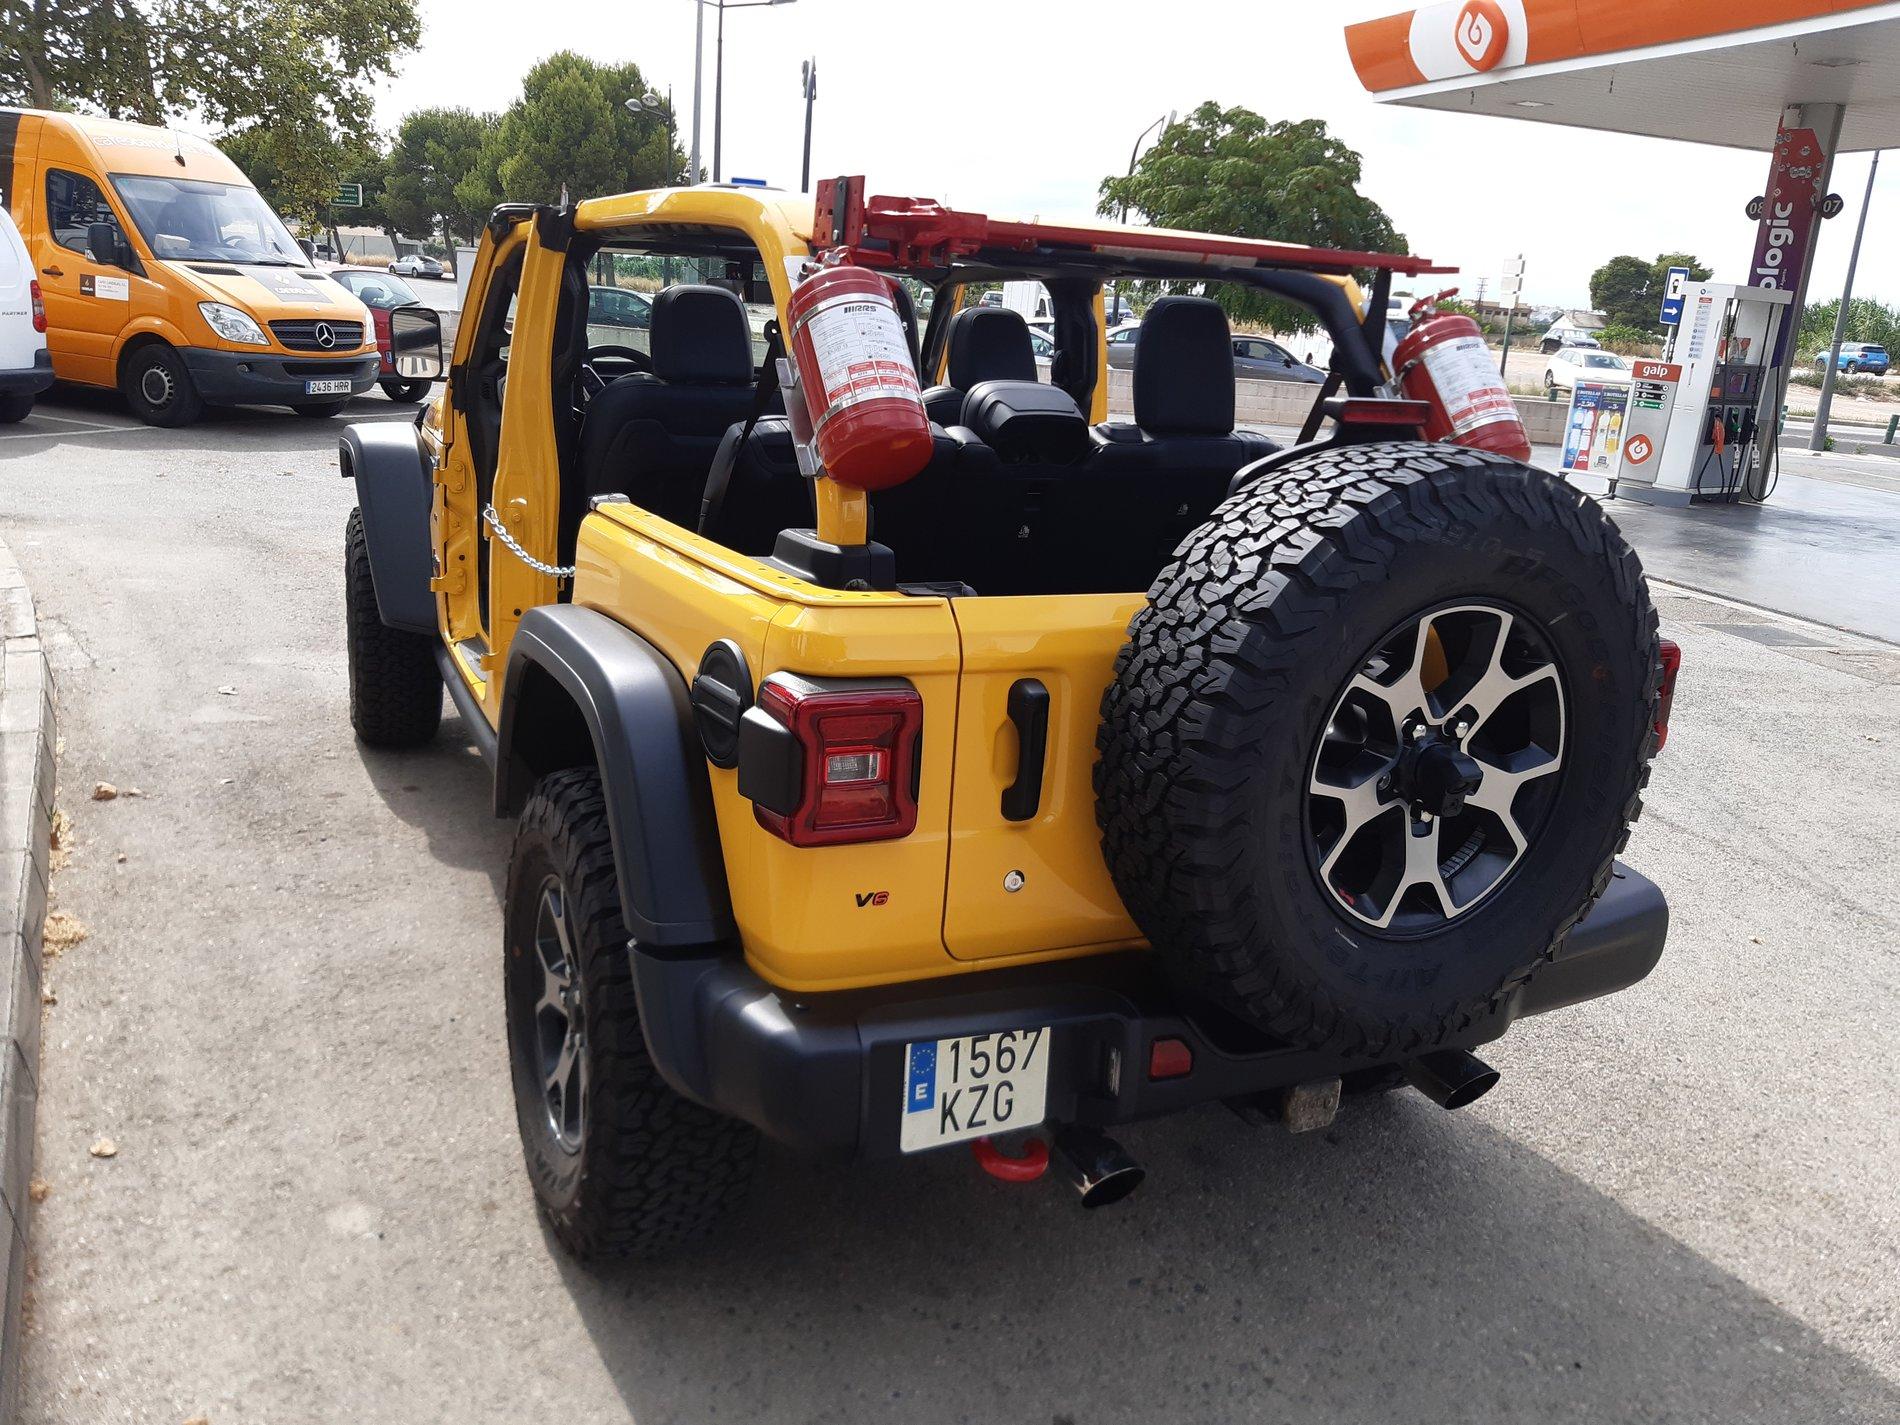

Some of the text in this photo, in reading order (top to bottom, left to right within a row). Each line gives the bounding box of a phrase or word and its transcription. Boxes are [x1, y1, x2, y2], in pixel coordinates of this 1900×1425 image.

[1822, 200, 1842, 214] 07
[1642, 365, 1668, 377] galp
[311, 381, 349, 392] 2436 HRR
[855, 890, 889, 908] V6
[949, 1030, 1043, 1083] 1567
[915, 1082, 928, 1100] E
[940, 1080, 1014, 1136] KZG
